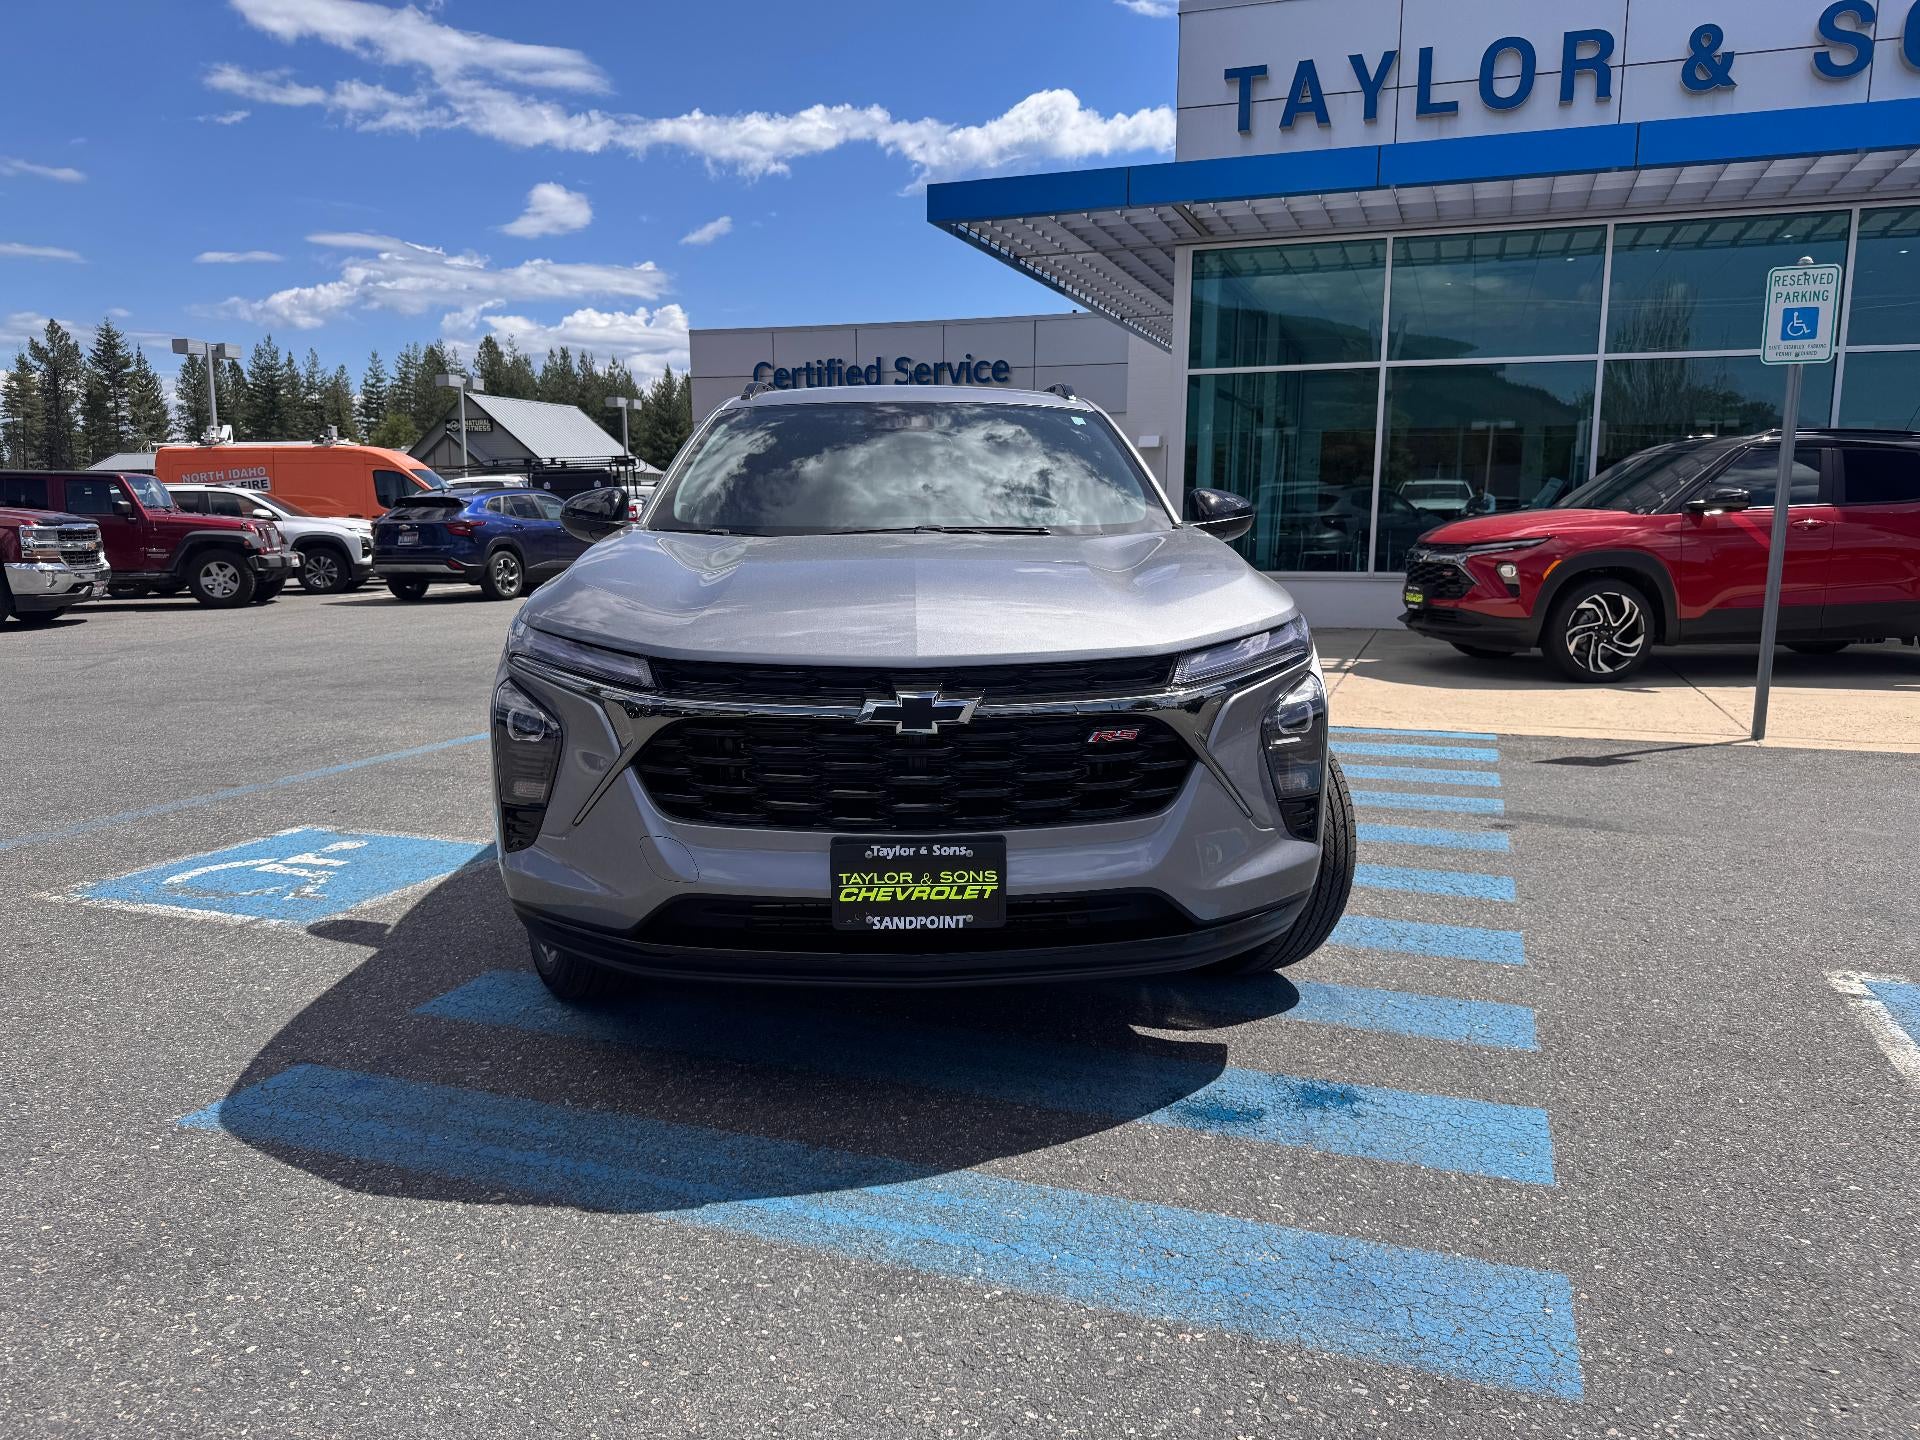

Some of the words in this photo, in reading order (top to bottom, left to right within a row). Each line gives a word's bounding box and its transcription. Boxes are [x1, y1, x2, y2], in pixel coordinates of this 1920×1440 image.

[1224, 28, 1616, 135] TAYLOR
[1680, 22, 1737, 95] &
[1774, 272, 1834, 287] RESERVED
[1775, 290, 1829, 304] PARKING
[753, 357, 882, 389] Certified
[894, 354, 1010, 386] Service
[181, 470, 225, 483] NORTH
[228, 466, 266, 479] IDAHO
[1088, 728, 1140, 743] RS
[870, 845, 915, 859] Taylor
[919, 846, 928, 855] &
[932, 844, 967, 856] Sons
[838, 872, 913, 885] TAYLOR
[920, 873, 933, 886] &
[939, 870, 998, 883] SONS
[839, 885, 999, 902] CHEVROLET
[872, 915, 967, 930] SANDPOINT
